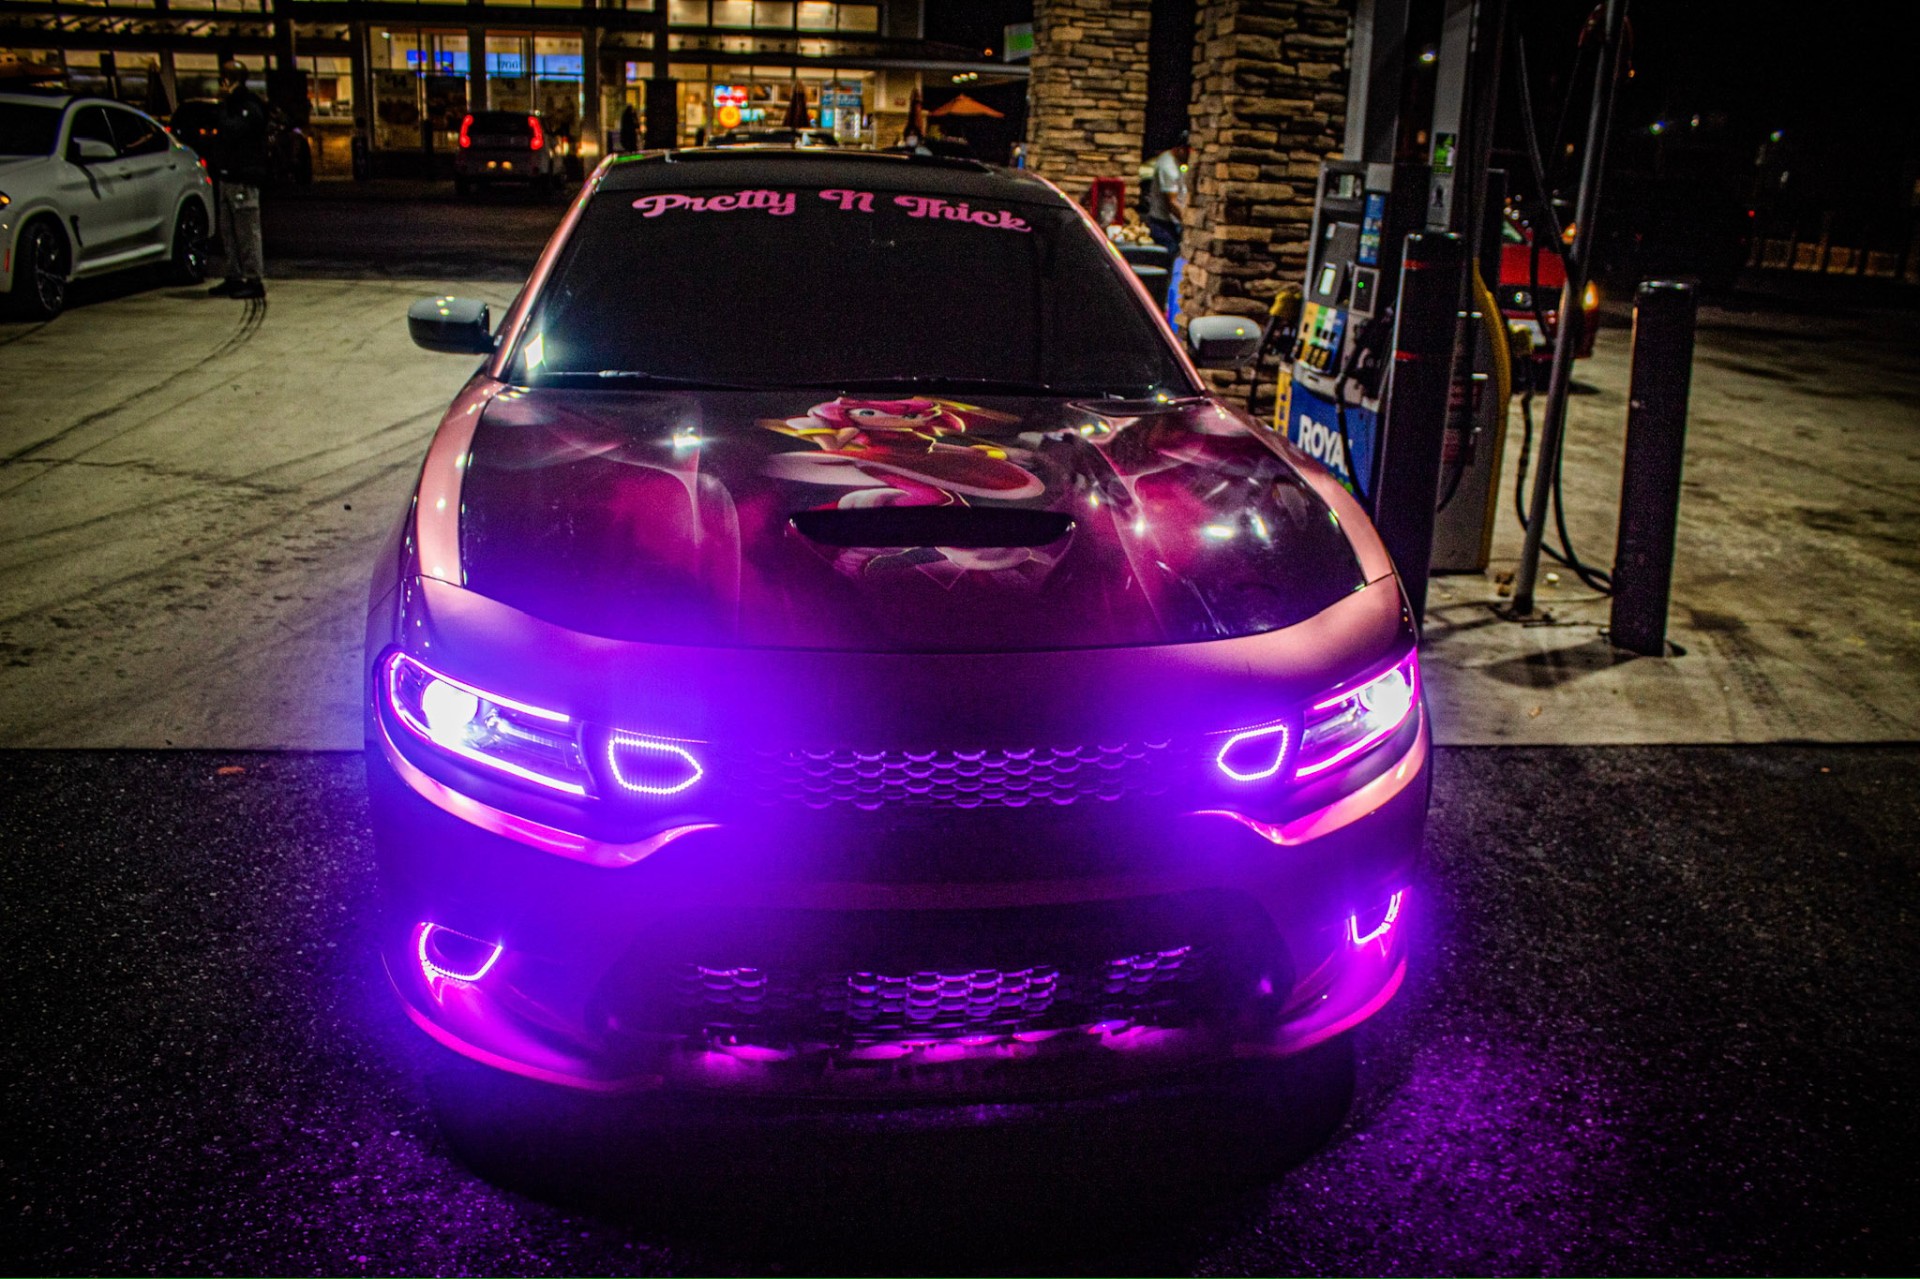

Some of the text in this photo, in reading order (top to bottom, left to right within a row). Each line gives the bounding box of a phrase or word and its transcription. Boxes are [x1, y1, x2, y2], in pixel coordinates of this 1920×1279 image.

[632, 189, 796, 217] Pretty
[894, 195, 1031, 232] Thick
[1298, 414, 1353, 476] ROYA
